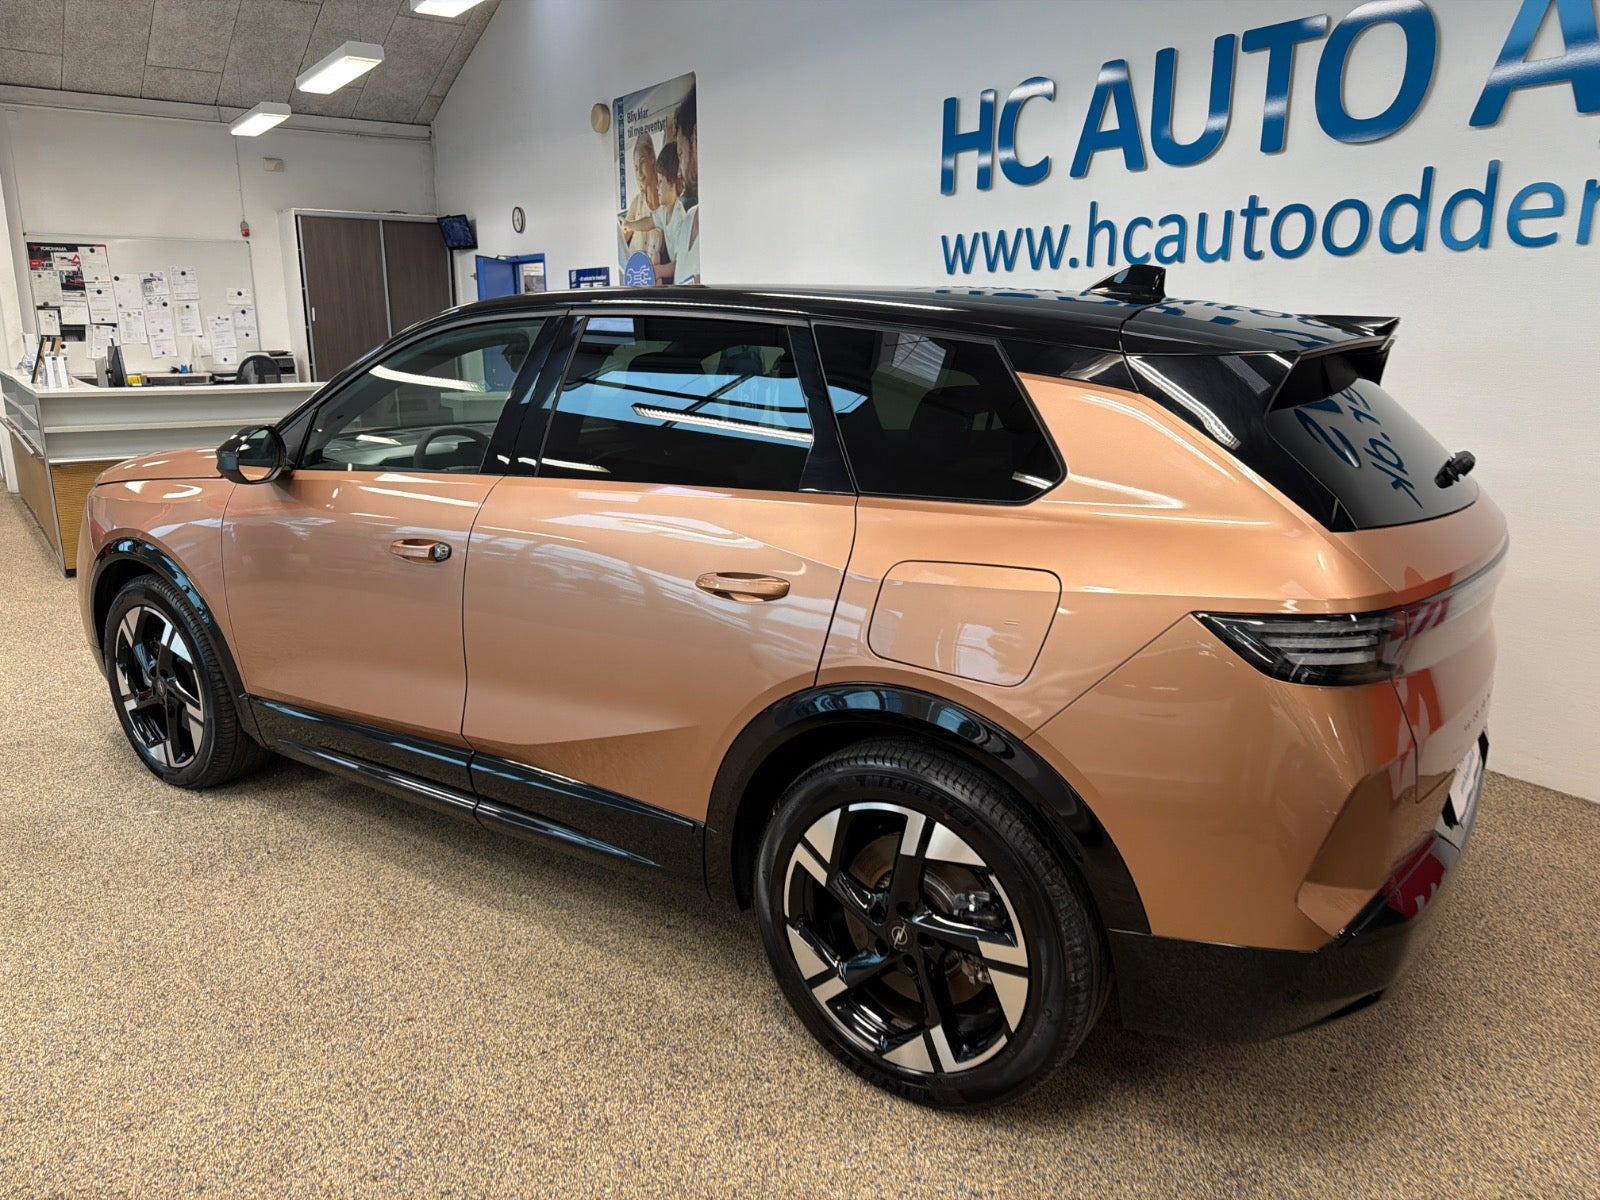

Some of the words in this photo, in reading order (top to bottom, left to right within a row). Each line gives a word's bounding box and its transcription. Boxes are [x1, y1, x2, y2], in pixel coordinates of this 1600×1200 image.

[626, 109, 637, 124] Bliv
[940, 77, 1055, 195] HC
[1069, 0, 1437, 178] AUTO
